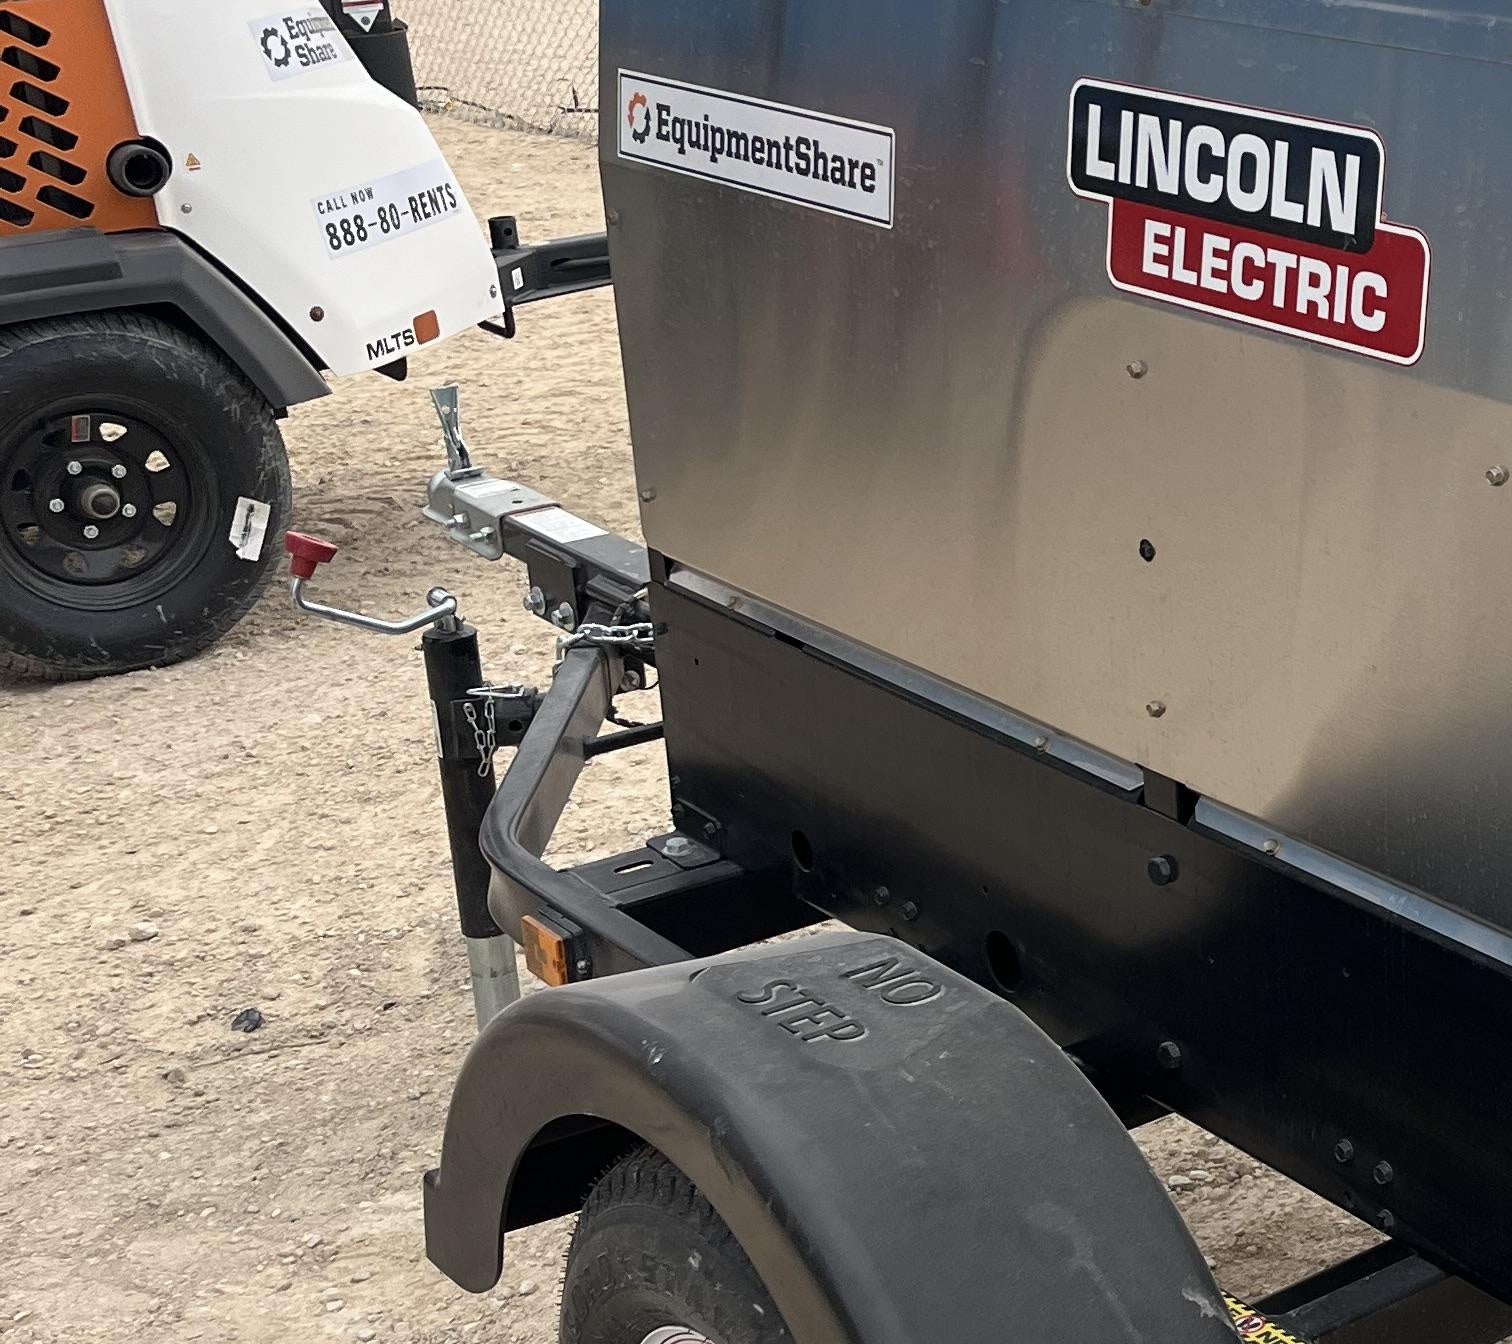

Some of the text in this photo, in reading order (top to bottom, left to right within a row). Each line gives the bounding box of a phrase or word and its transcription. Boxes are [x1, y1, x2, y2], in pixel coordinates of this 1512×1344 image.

[294, 43, 338, 67] Share
[655, 102, 877, 194] EquipmentShare
[1085, 103, 1361, 236] LINCOLN
[317, 187, 374, 215] CALL NOW
[325, 183, 458, 251] 888-80-RENTS
[1142, 218, 1388, 333] ELECTRIC
[366, 328, 415, 360] MLTS
[736, 979, 870, 1043] STEP
[838, 957, 946, 1007] NO
